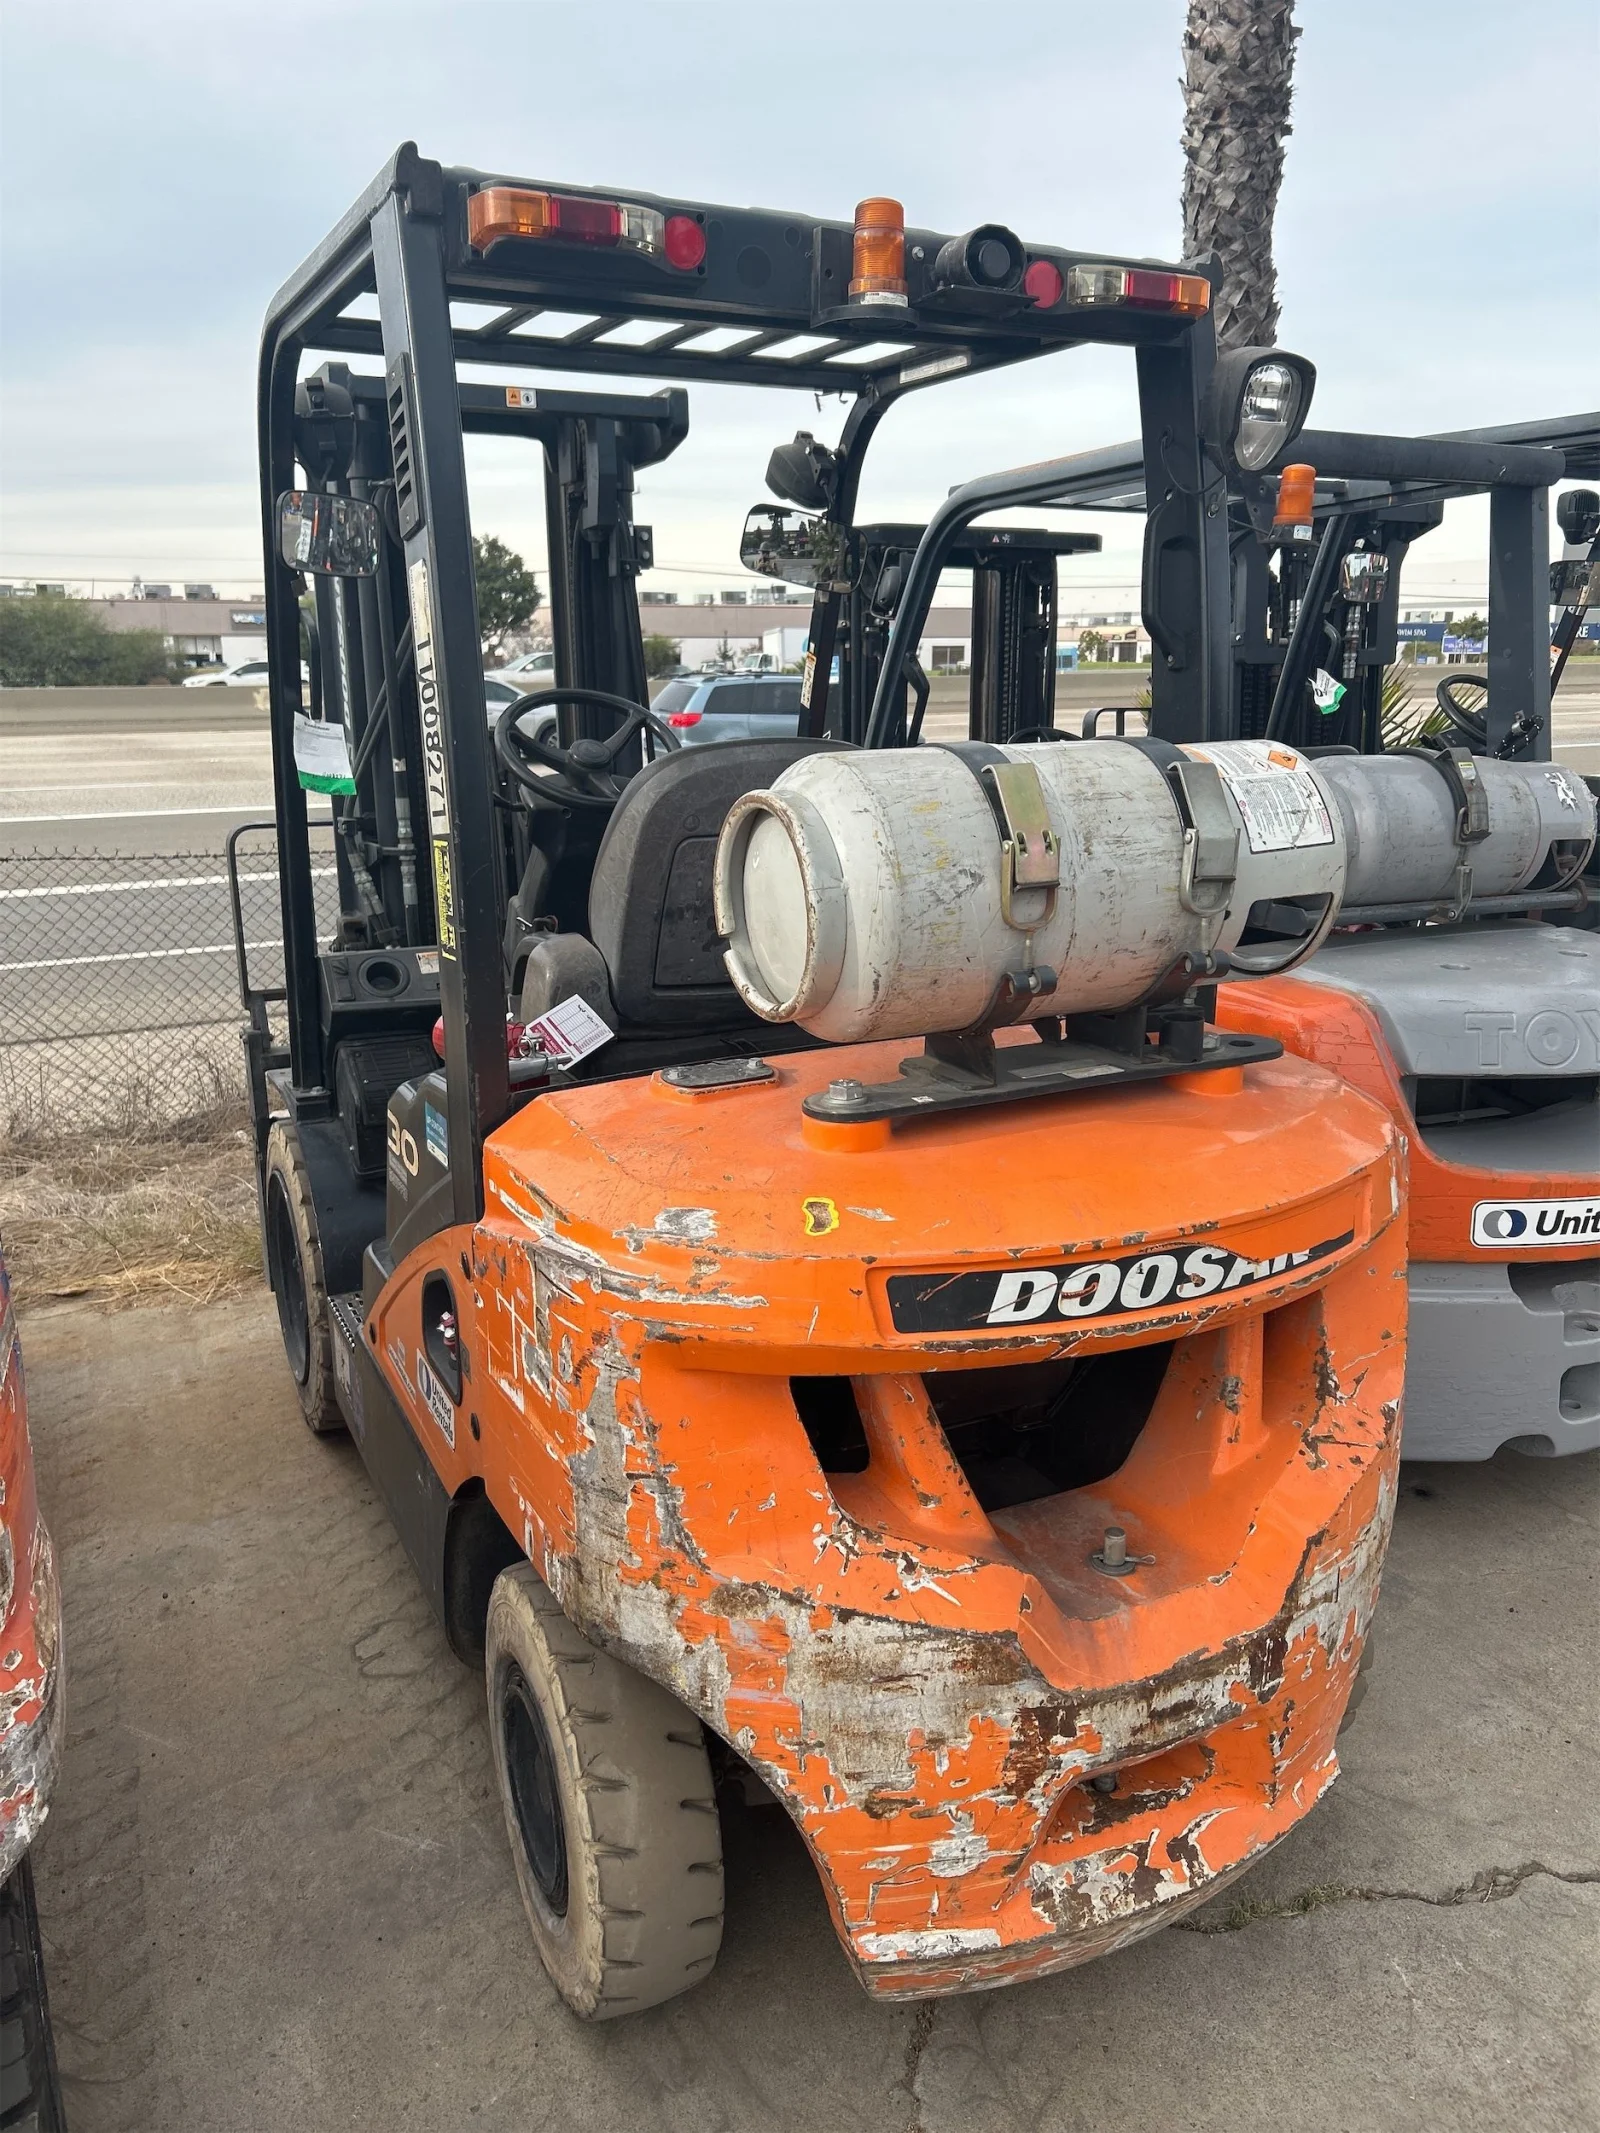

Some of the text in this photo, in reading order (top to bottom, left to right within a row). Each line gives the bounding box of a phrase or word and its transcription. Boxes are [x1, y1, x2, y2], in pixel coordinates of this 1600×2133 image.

[1413, 628, 1427, 637] SPAS
[417, 632, 447, 818] 11008271
[387, 1108, 419, 1177] 30
[431, 1395, 454, 1442] Rentals
[432, 1378, 452, 1421] United
